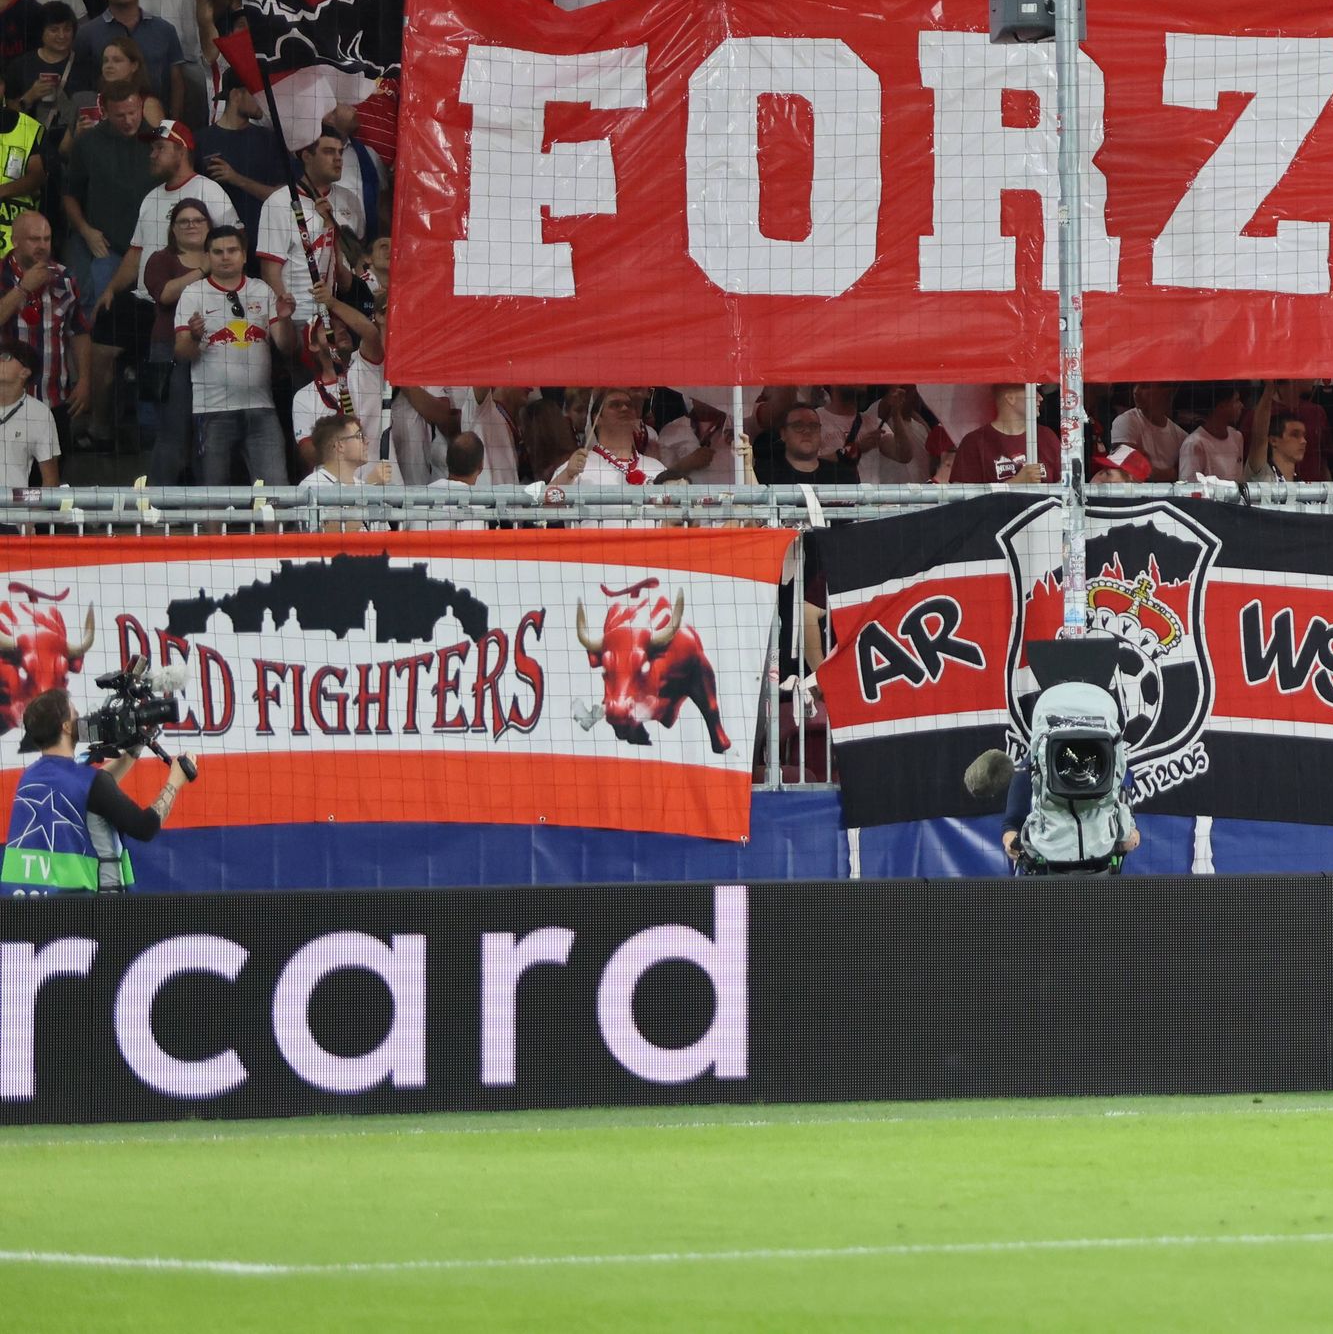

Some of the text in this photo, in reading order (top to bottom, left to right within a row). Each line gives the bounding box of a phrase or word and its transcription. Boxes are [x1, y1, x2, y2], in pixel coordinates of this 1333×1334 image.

[252, 607, 547, 743] FIGHTERS
[856, 594, 986, 704] AR
[21, 853, 51, 880] TV
